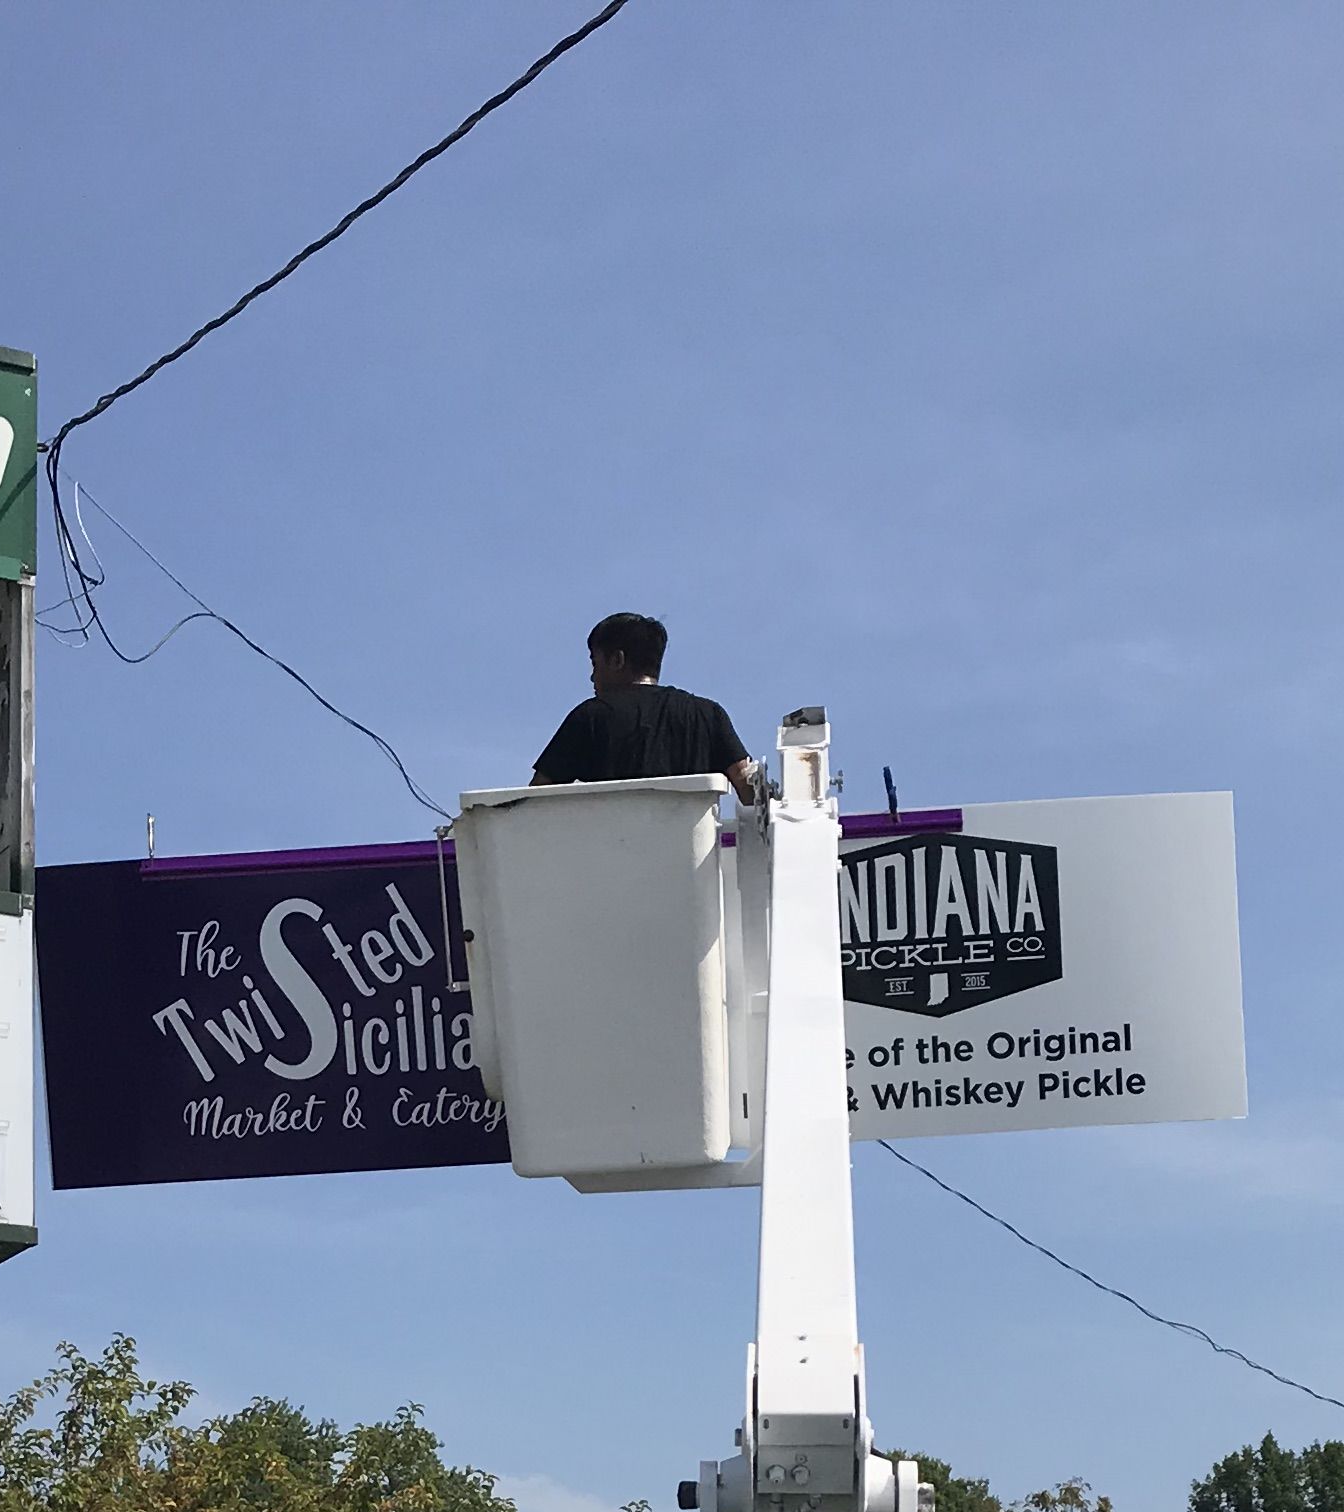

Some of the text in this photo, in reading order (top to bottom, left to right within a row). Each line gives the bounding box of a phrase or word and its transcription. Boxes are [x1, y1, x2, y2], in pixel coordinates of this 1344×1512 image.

[840, 844, 1046, 945] NDIANA
[176, 920, 242, 979] The
[1006, 936, 1046, 954] CO.
[965, 975, 986, 988] 2015
[867, 1037, 905, 1069] of
[915, 1035, 974, 1066] the
[986, 1023, 1133, 1062] Original
[870, 1074, 1025, 1112] Whiskey
[1037, 1067, 1147, 1101] Pickle
[183, 1086, 506, 1140] Market & Eatery
